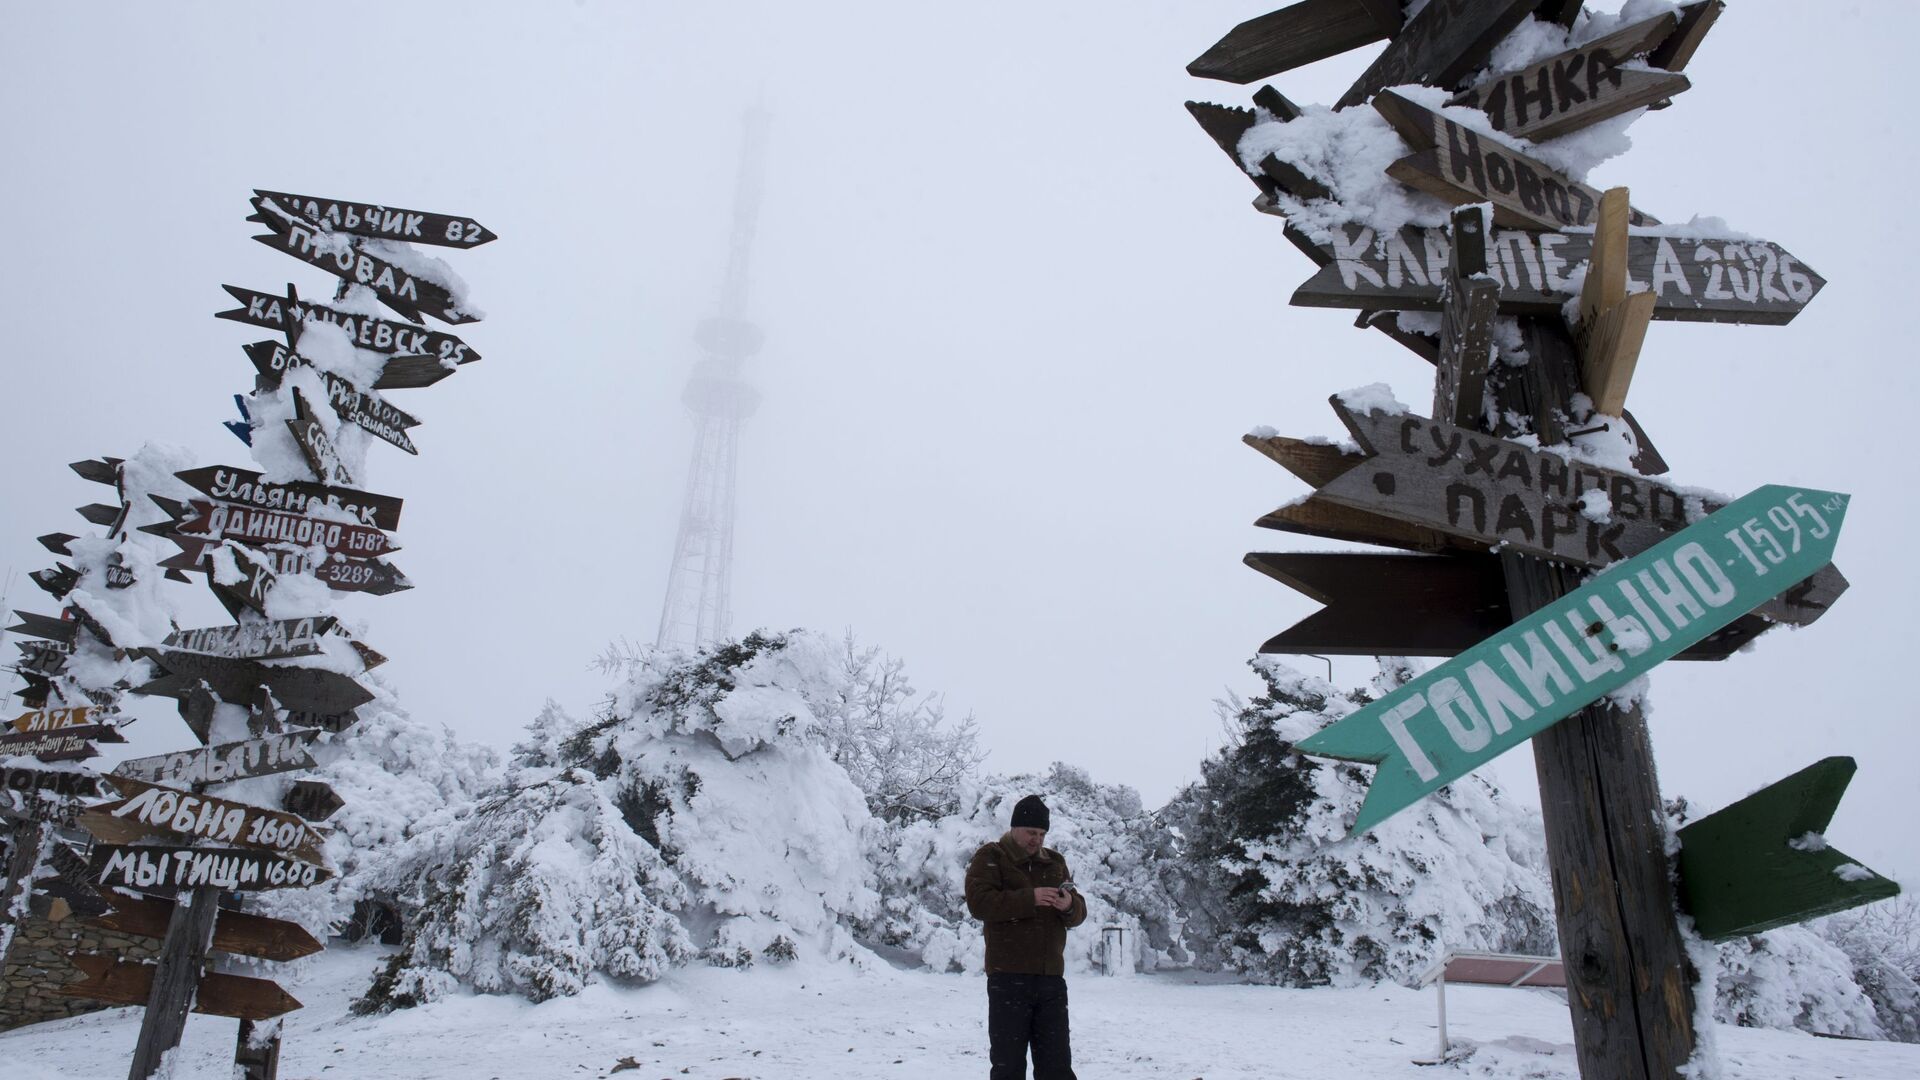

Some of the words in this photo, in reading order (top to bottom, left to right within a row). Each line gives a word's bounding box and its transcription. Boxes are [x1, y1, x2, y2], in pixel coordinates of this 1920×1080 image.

[283, 197, 423, 237] АЛЬЧИК
[445, 220, 482, 243] 82
[1330, 225, 1692, 297] КЛАПЕА
[1694, 243, 1813, 303] 2026
[1446, 484, 1626, 563] ПАРК
[26, 710, 74, 731] ЯЛТА
[111, 788, 245, 842] ЛОБНЯ
[246, 815, 305, 849] 1601
[265, 860, 316, 887] 1600
